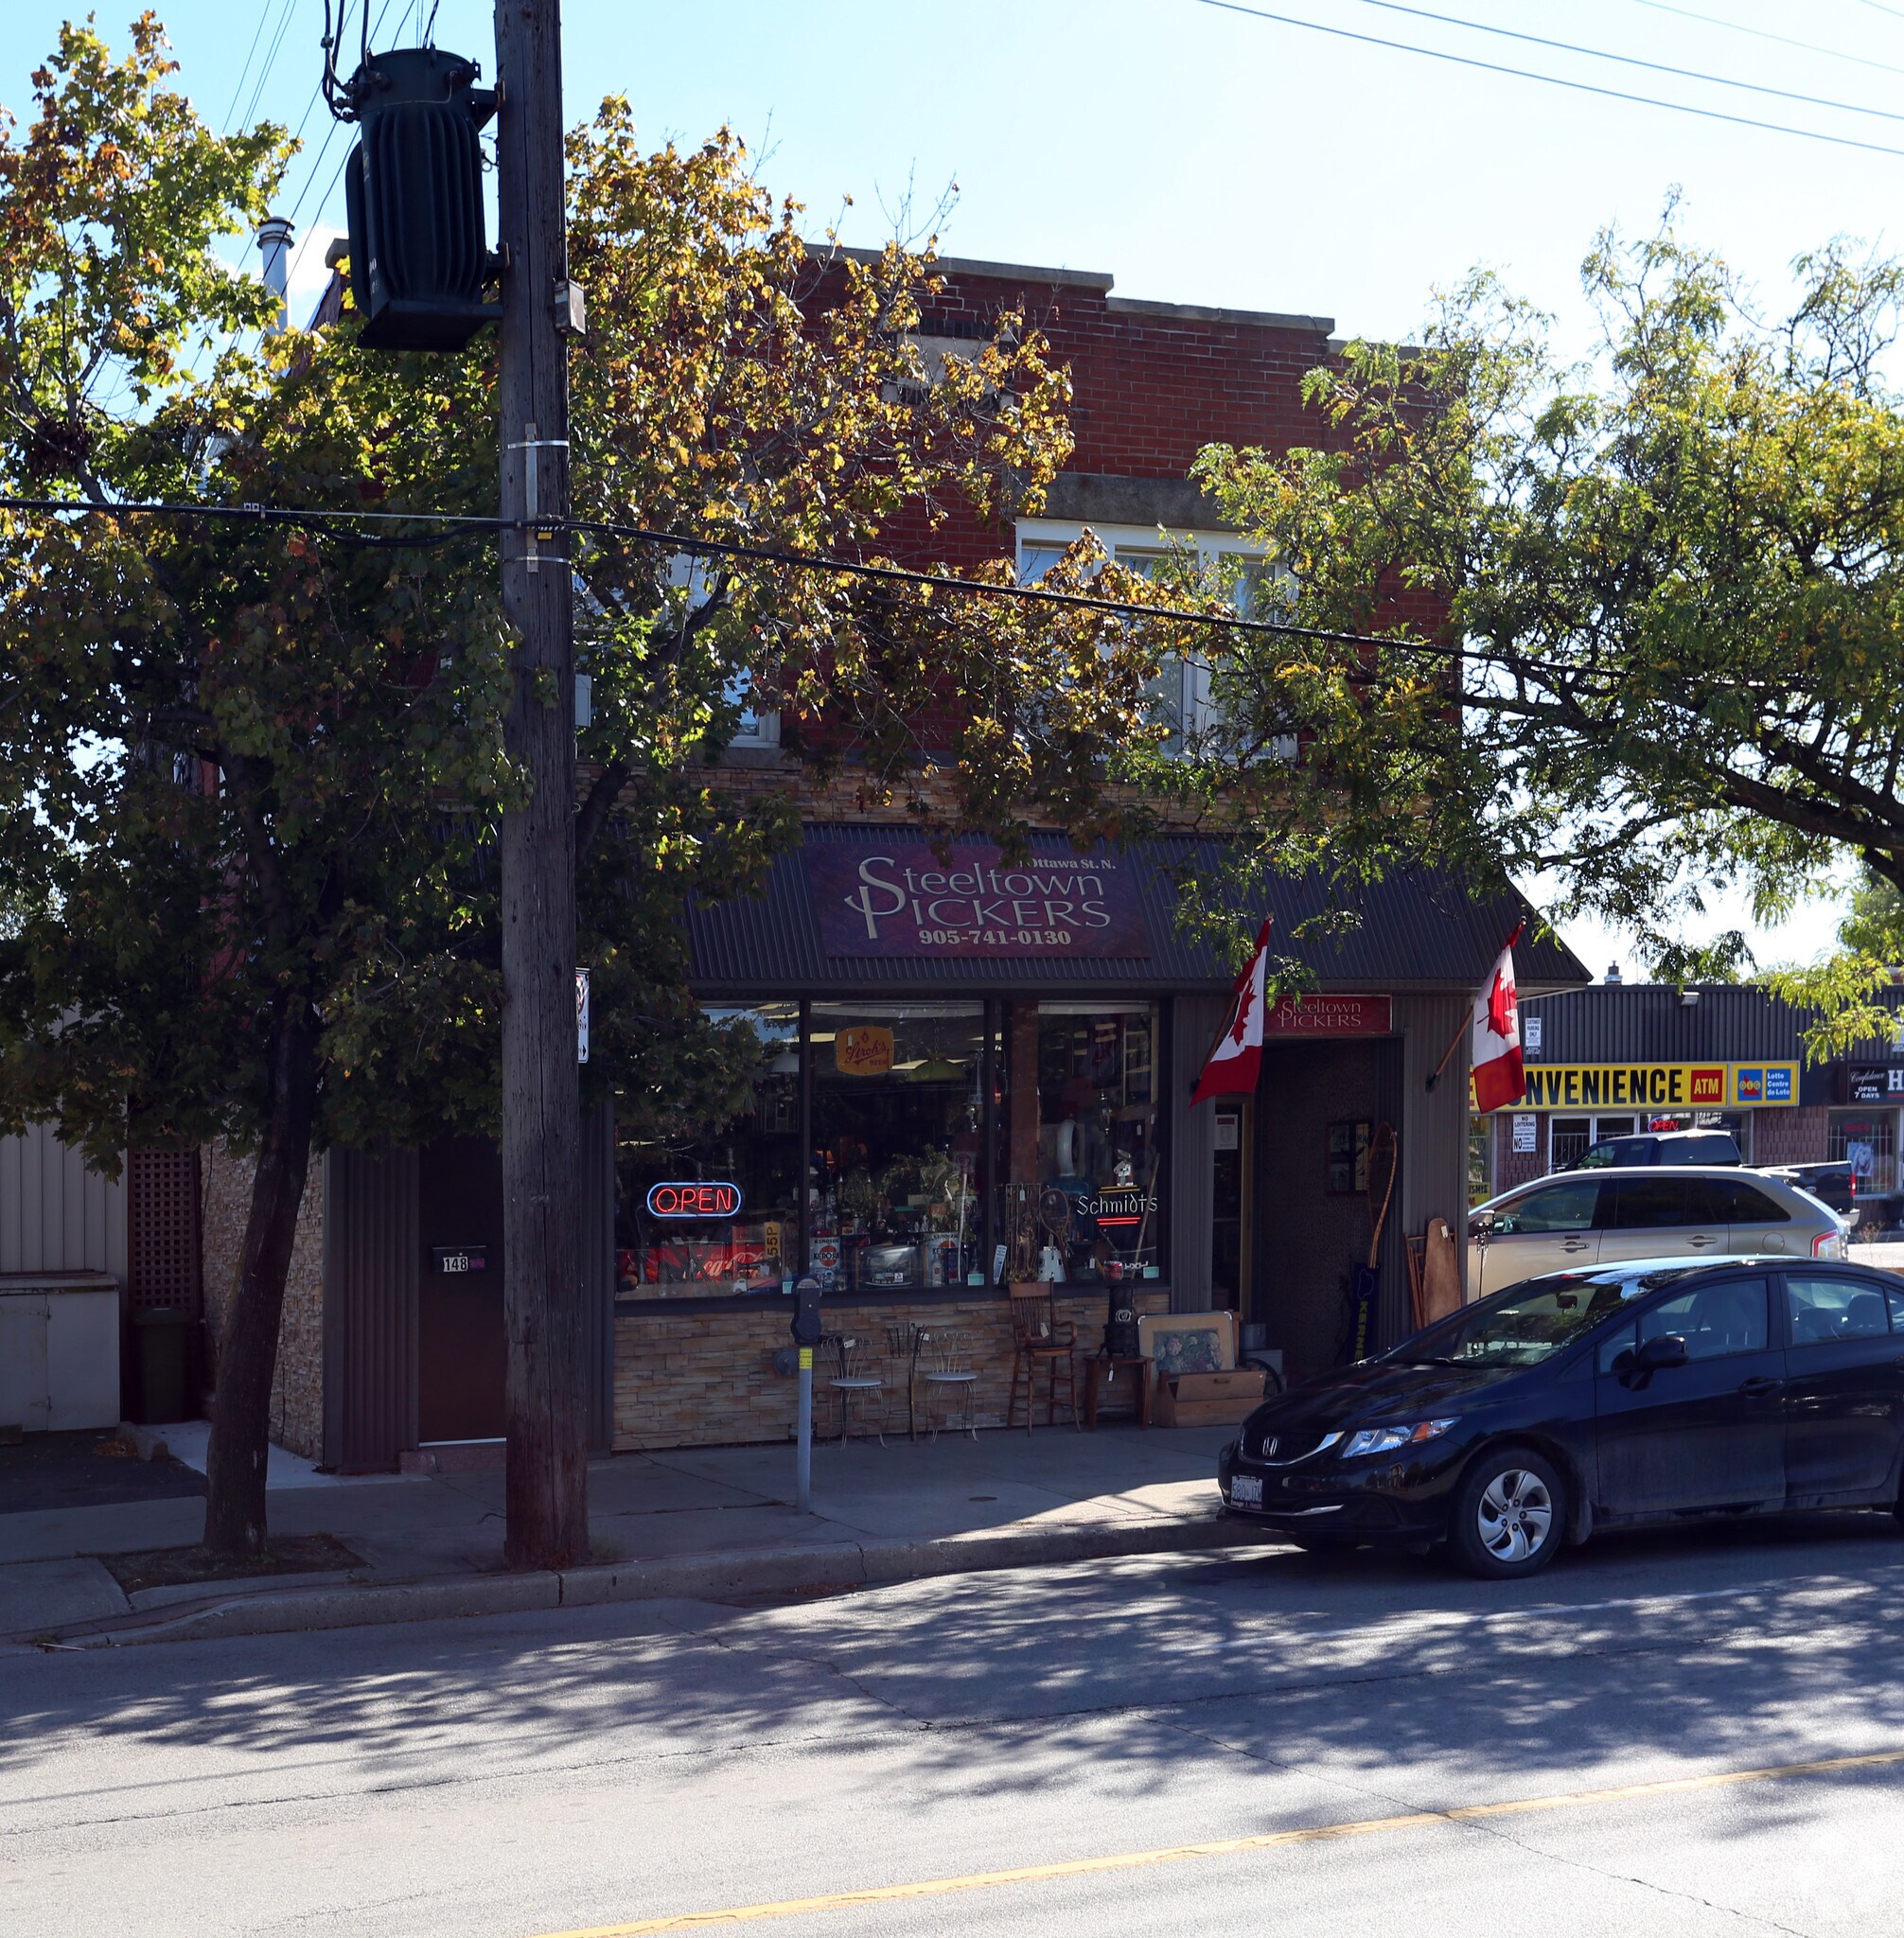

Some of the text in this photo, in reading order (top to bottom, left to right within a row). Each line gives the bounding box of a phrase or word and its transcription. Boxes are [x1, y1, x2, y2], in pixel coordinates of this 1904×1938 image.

[1081, 858, 1100, 869] St.
[1101, 858, 1117, 870] N.
[844, 856, 1105, 914] Steeltown
[857, 886, 1112, 940] PICKERS
[918, 929, 1071, 945] 905-741-0130
[1278, 998, 1361, 1020] Steeltown
[1279, 1010, 1362, 1028] PICKERS
[1850, 1070, 1885, 1085] Confidence
[1508, 1069, 1683, 1106] NVENIENCE
[1693, 1078, 1719, 1094] ATM
[1649, 1119, 1679, 1131] OPEN
[1514, 1136, 1523, 1150] NO
[656, 1188, 732, 1213] OPEN
[445, 1258, 467, 1271] 148
